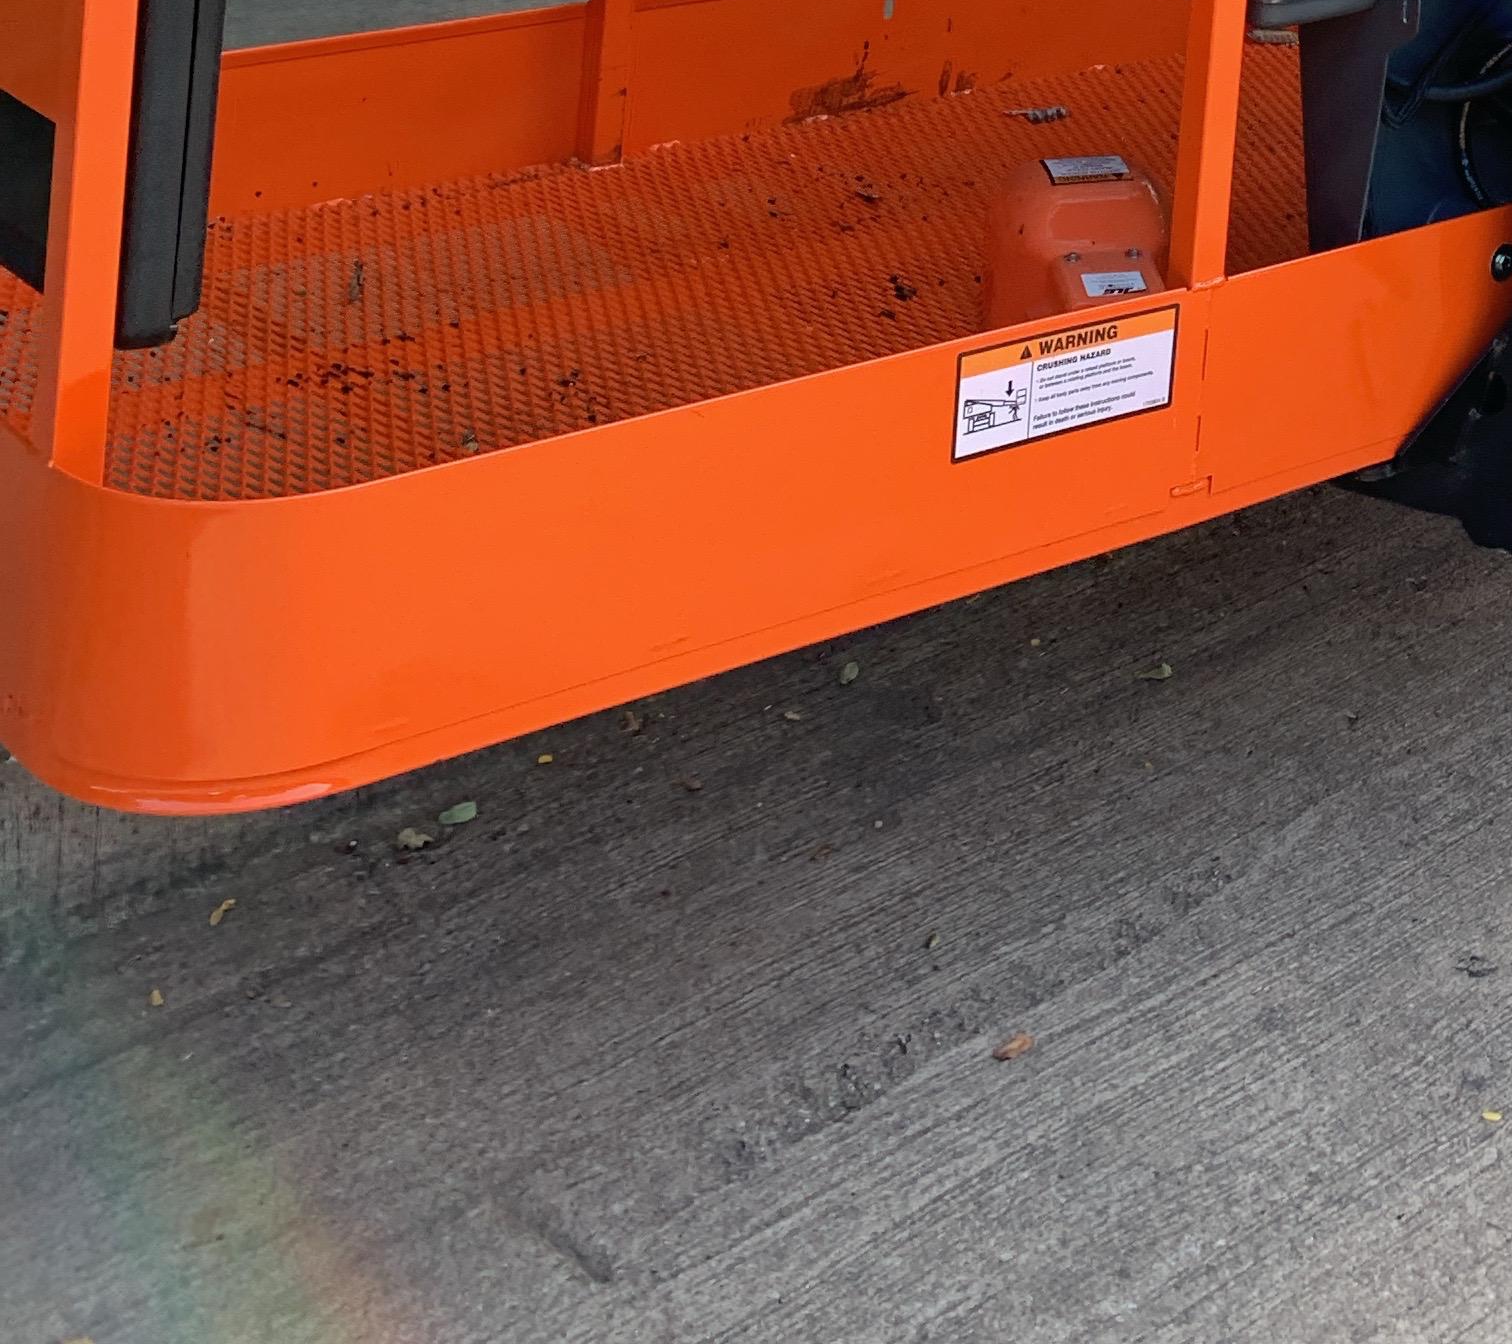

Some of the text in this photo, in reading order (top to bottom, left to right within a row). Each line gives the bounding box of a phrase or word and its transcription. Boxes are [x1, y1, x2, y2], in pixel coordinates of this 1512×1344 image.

[1039, 325, 1118, 356] WARNING
[1036, 348, 1112, 372] CRUSHING HAZARD
